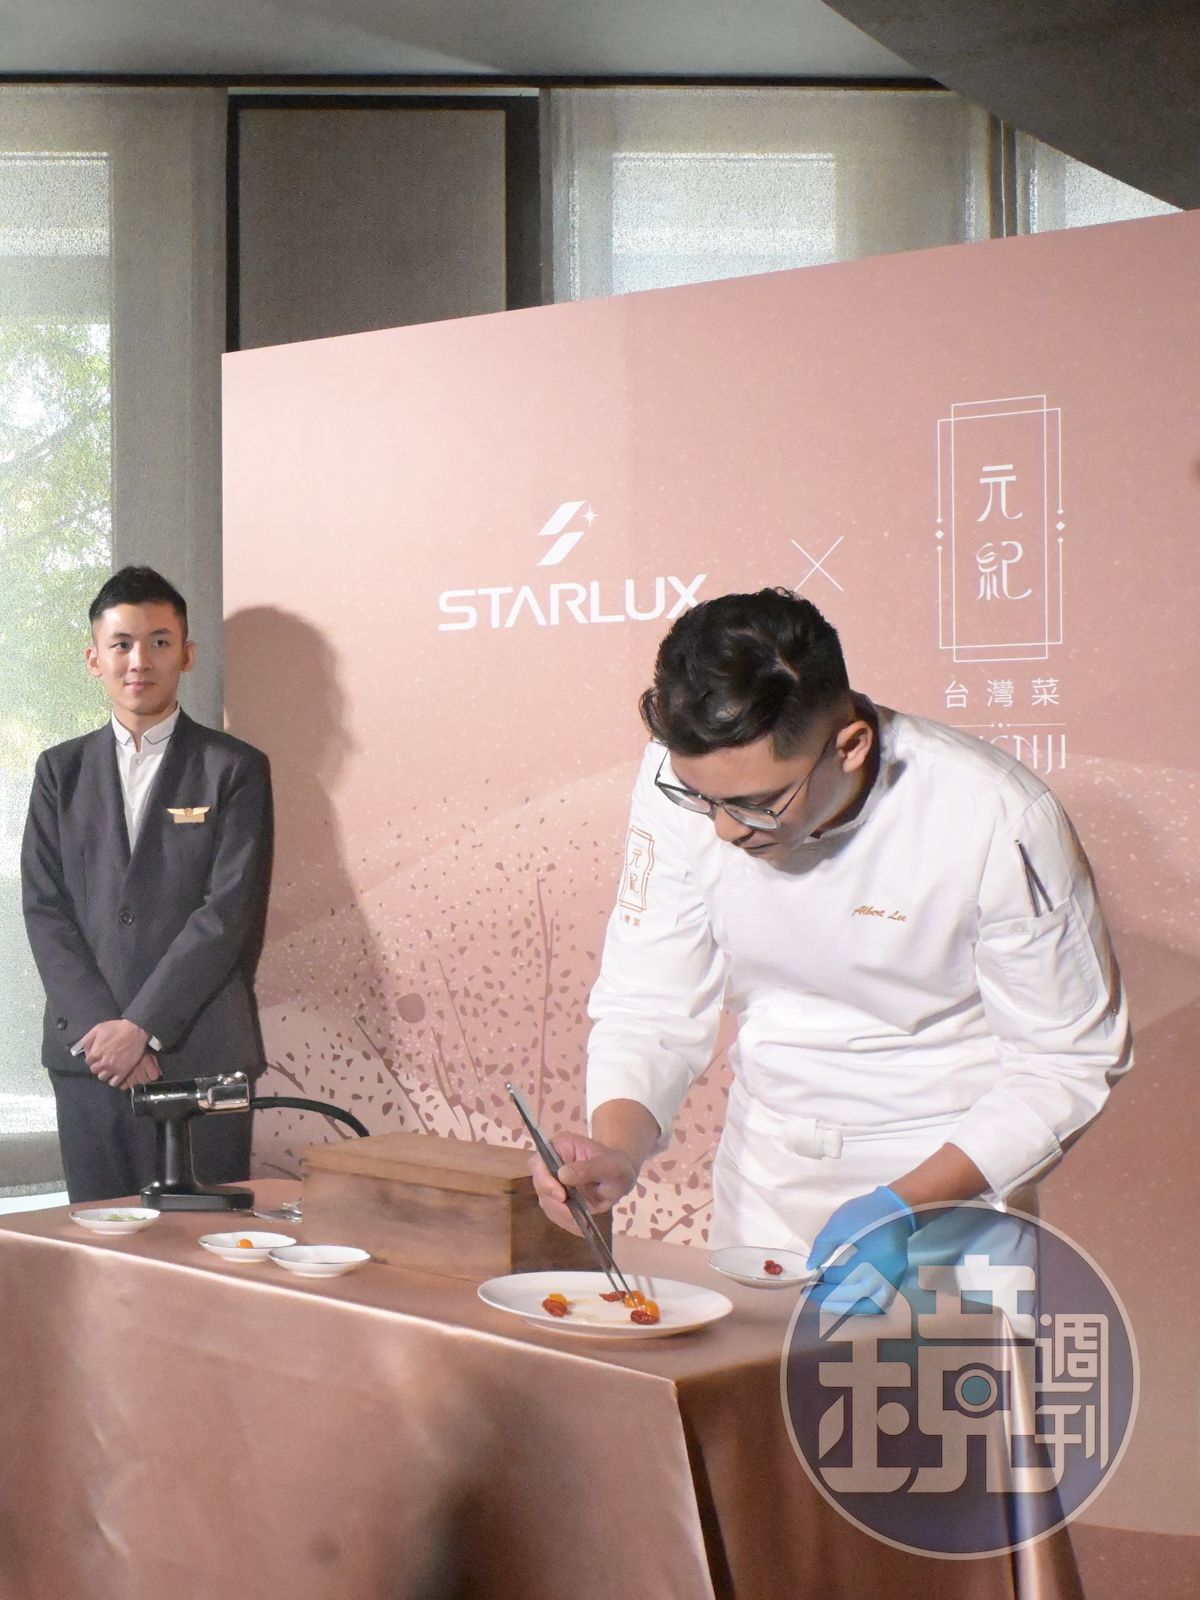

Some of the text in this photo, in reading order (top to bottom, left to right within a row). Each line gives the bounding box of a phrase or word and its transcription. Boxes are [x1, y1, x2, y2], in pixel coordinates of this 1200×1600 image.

[975, 463, 1033, 601] 元紀
[437, 573, 708, 632] STARLUX
[944, 677, 1060, 709] 台灣菜
